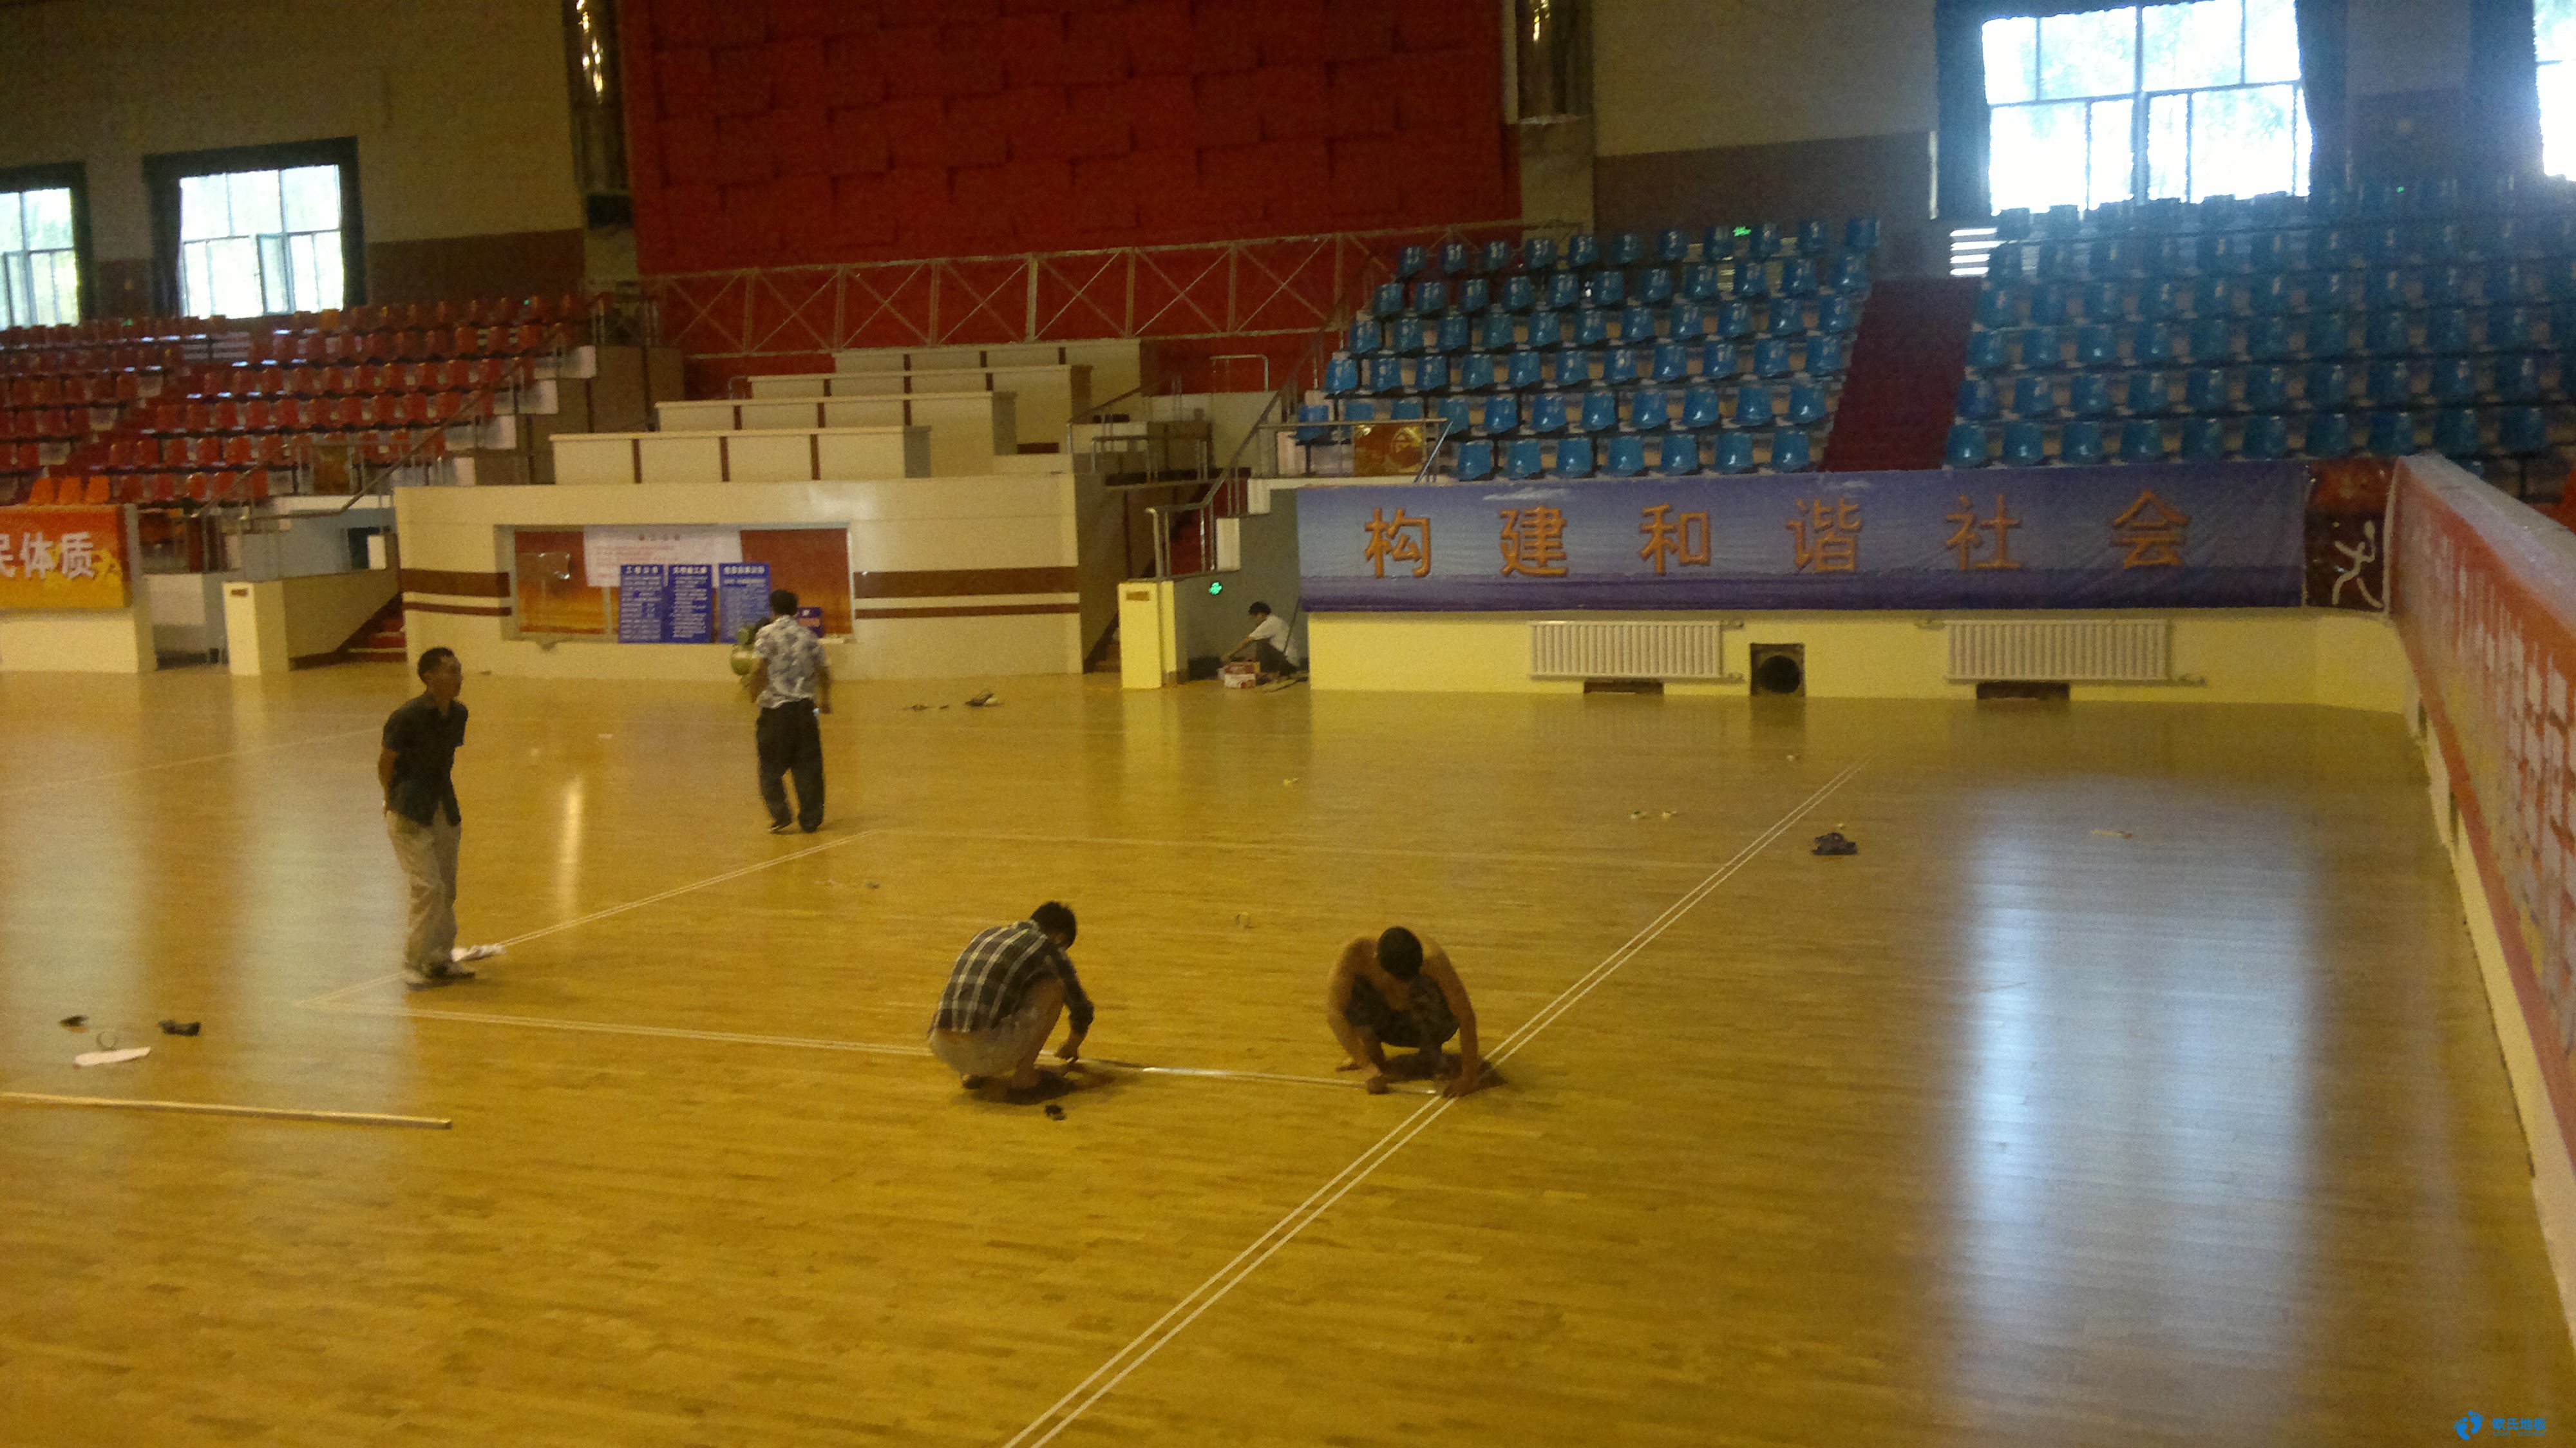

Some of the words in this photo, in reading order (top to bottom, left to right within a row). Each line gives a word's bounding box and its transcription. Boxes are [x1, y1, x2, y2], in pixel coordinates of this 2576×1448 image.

[1364, 489, 2189, 578] 构建和谐社会
